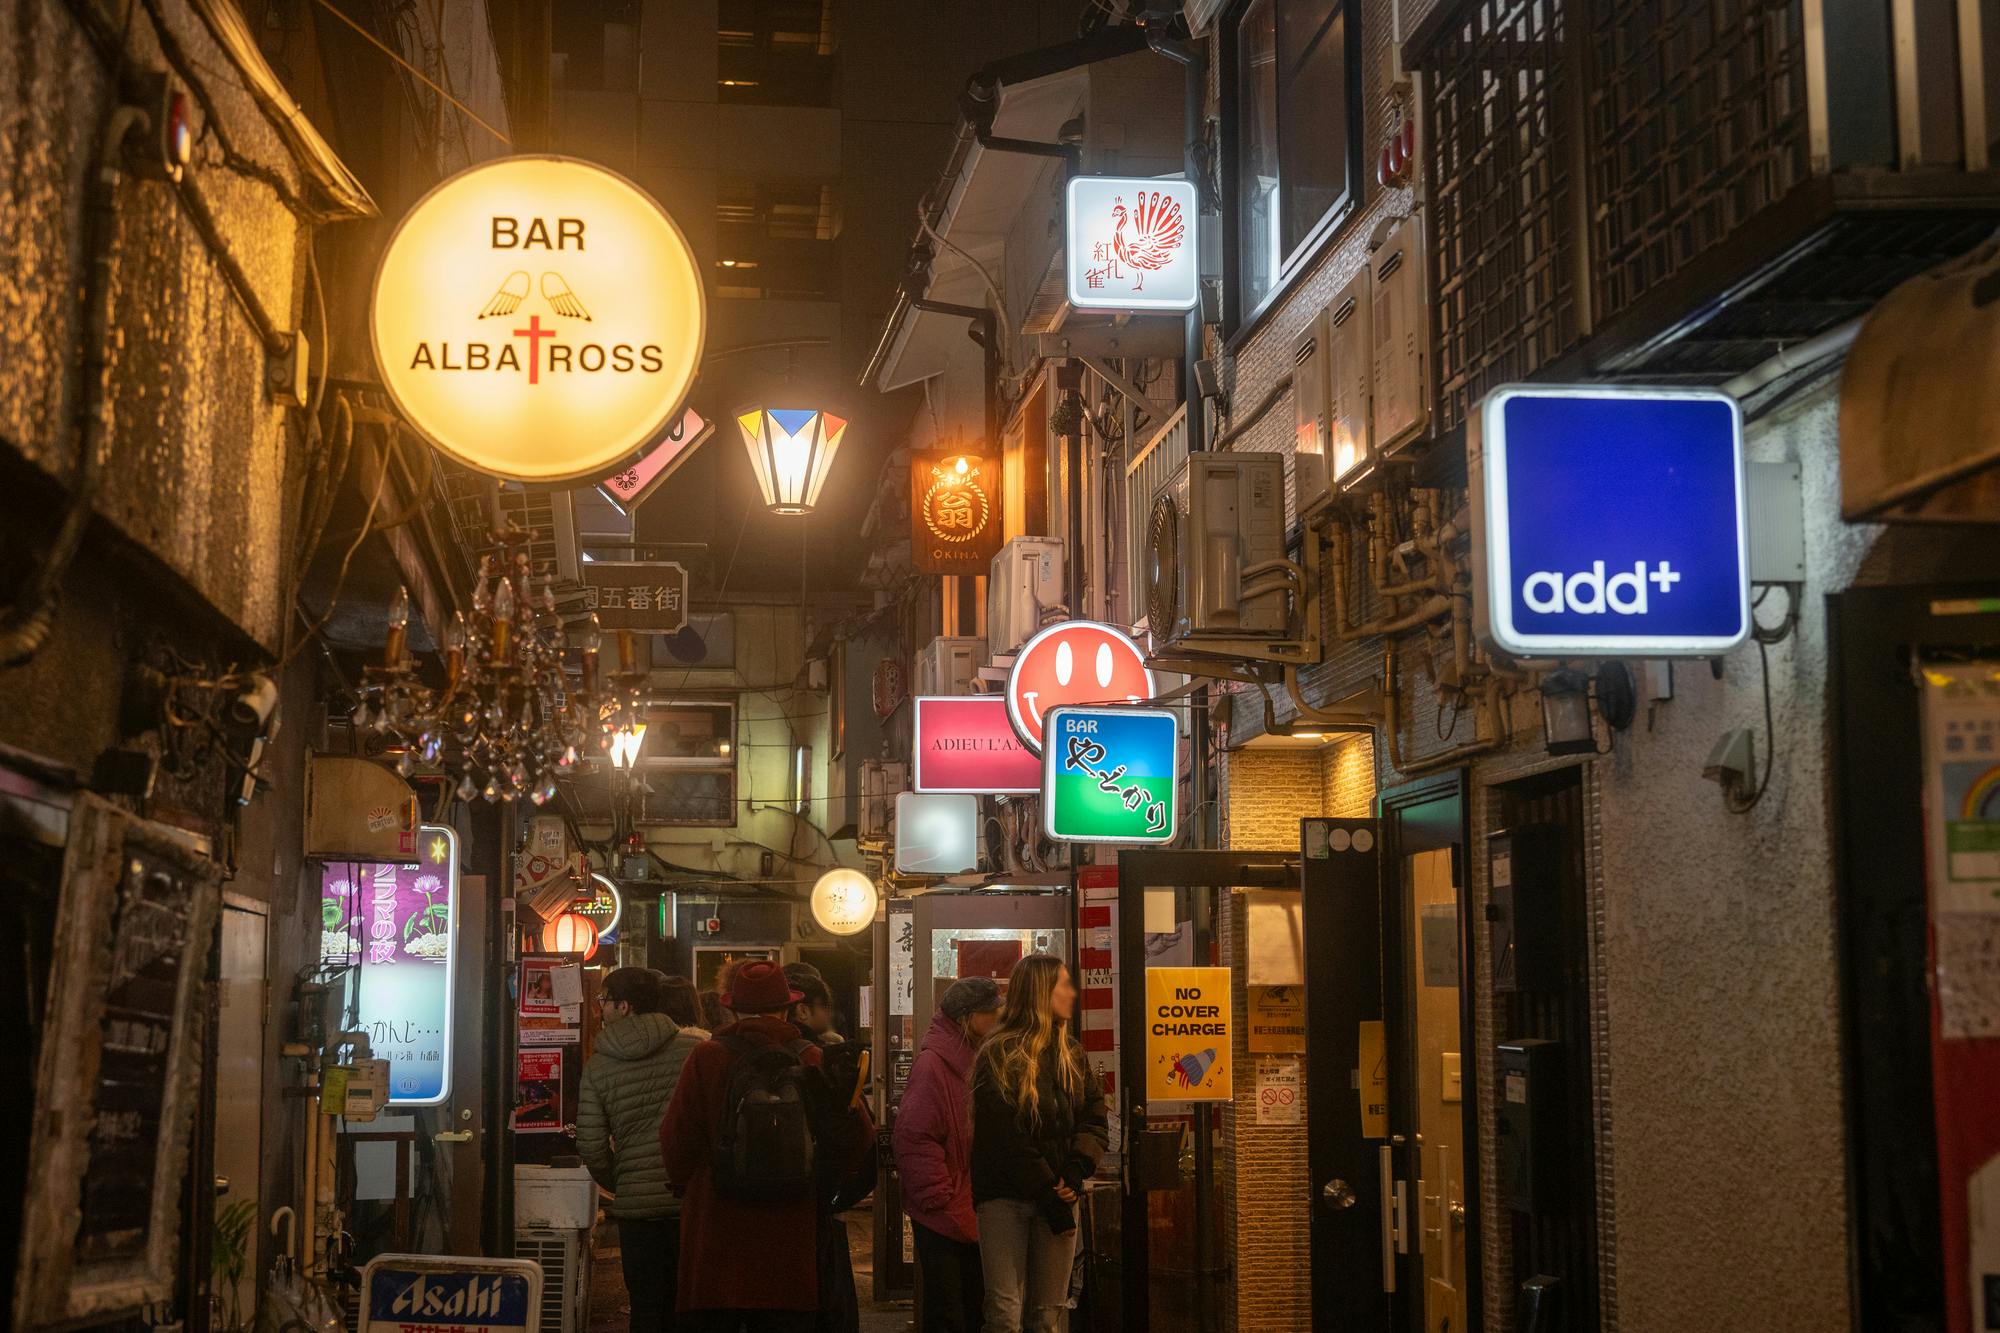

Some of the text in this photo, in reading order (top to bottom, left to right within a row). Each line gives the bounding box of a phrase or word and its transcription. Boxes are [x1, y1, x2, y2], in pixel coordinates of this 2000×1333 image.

[492, 217, 586, 252] BAR
[937, 491, 973, 528] 翁
[933, 549, 979, 560] OKINA
[1522, 561, 1680, 615] add+
[1066, 719, 1098, 734] BAR
[932, 738, 983, 751] ADIEU
[1065, 735, 1166, 833] やどかり
[1176, 988, 1201, 1000] NO
[1158, 1005, 1220, 1018] COVER
[1151, 1023, 1226, 1036] CHARGE
[391, 1275, 503, 1318] Asahi
